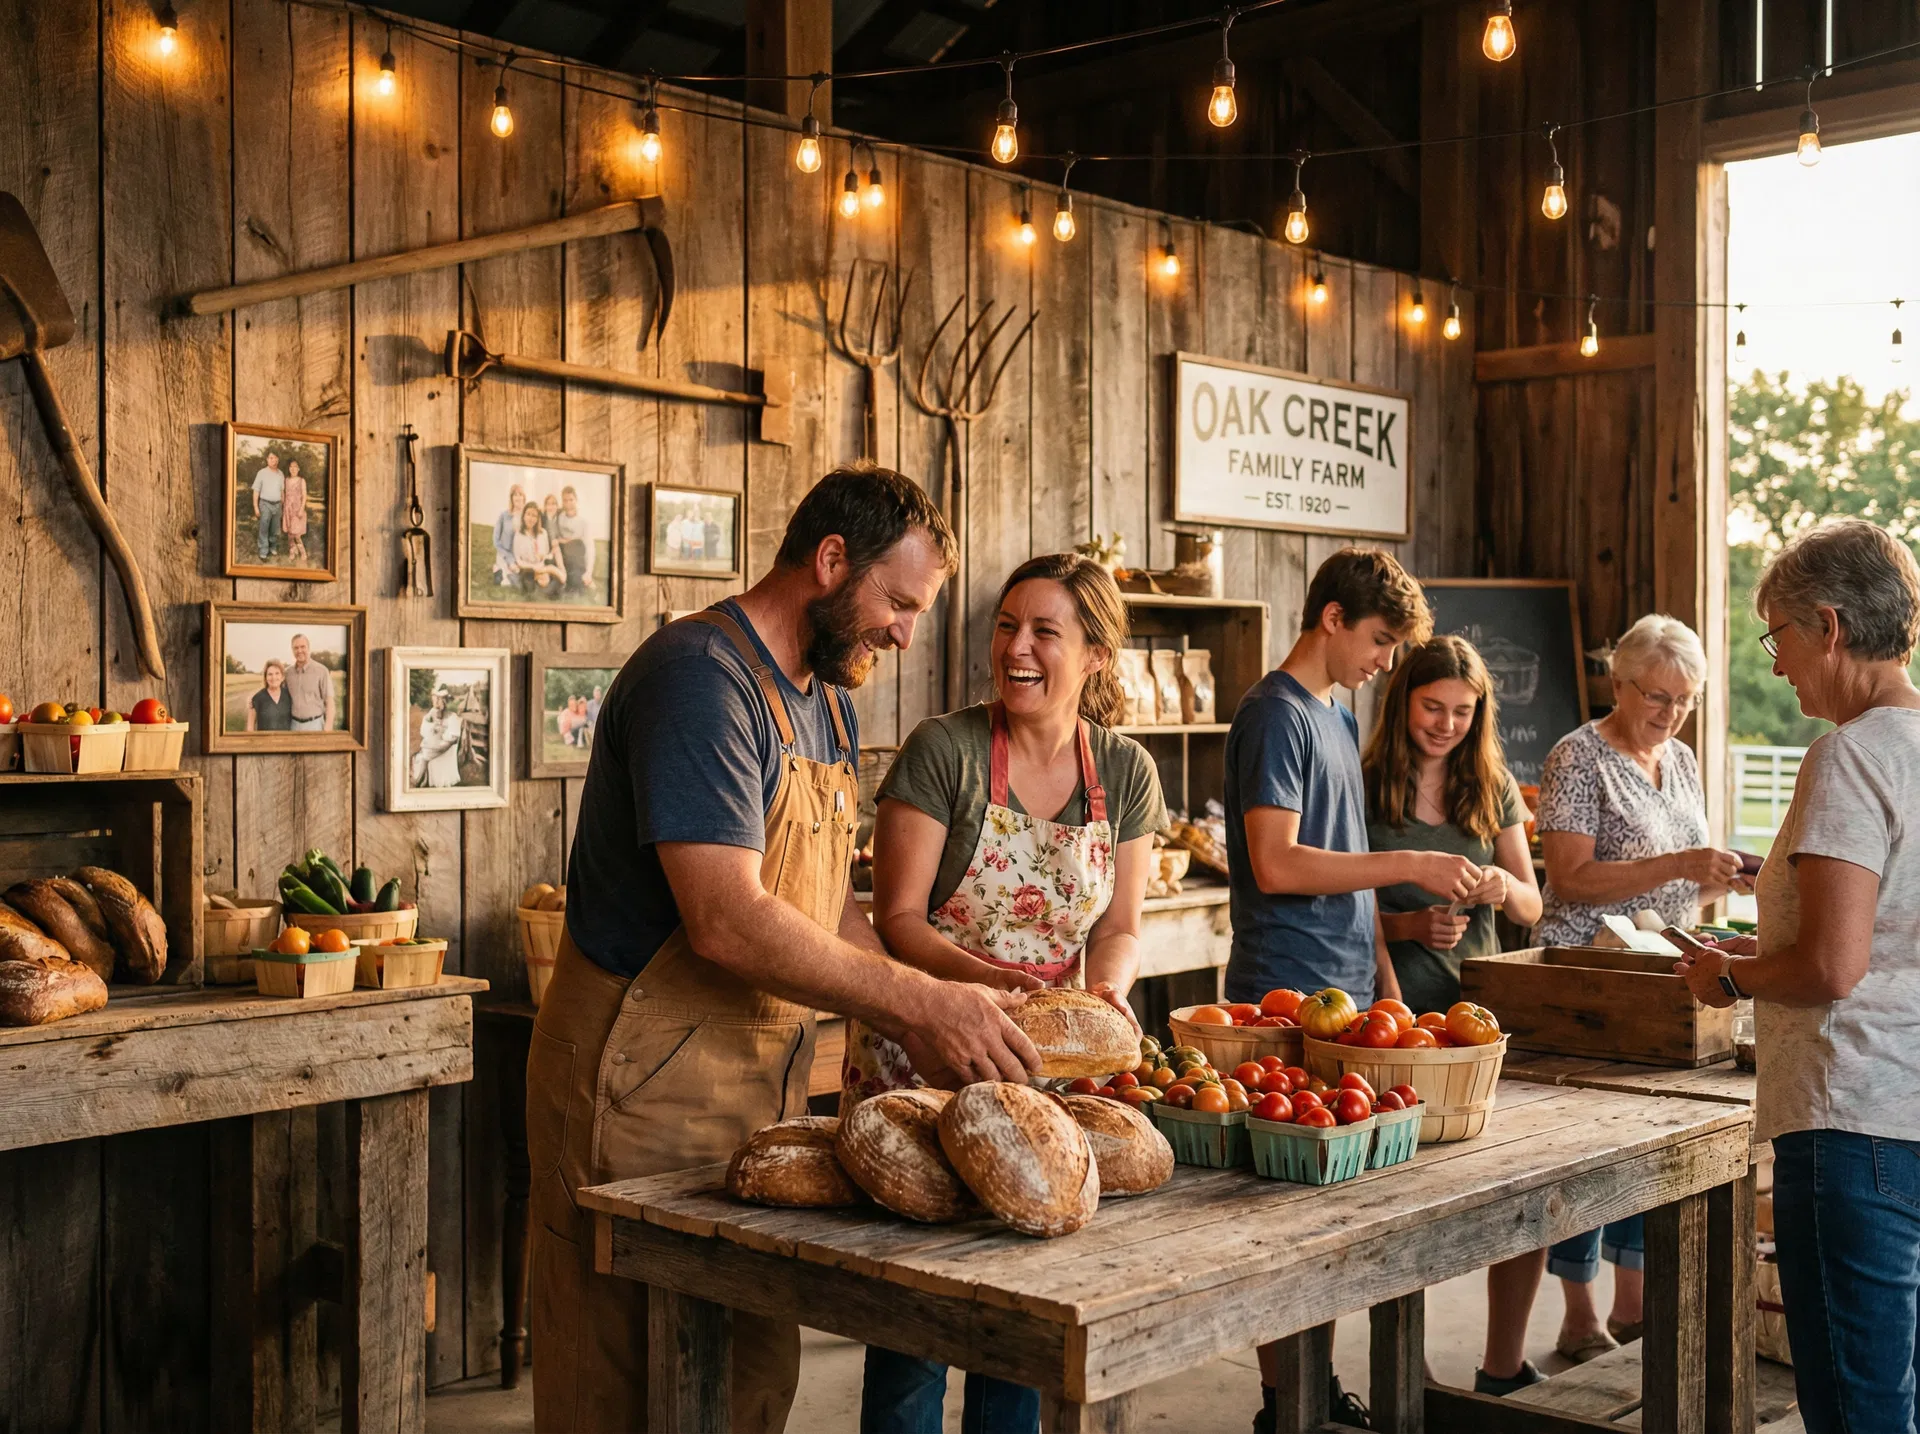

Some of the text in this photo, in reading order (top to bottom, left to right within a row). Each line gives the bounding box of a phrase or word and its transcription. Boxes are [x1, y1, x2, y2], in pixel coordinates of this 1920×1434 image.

[1191, 381, 1397, 469] OAK CREEK
[1228, 449, 1365, 489] FAMILY FARM
[1265, 491, 1331, 514] EST. 1920
